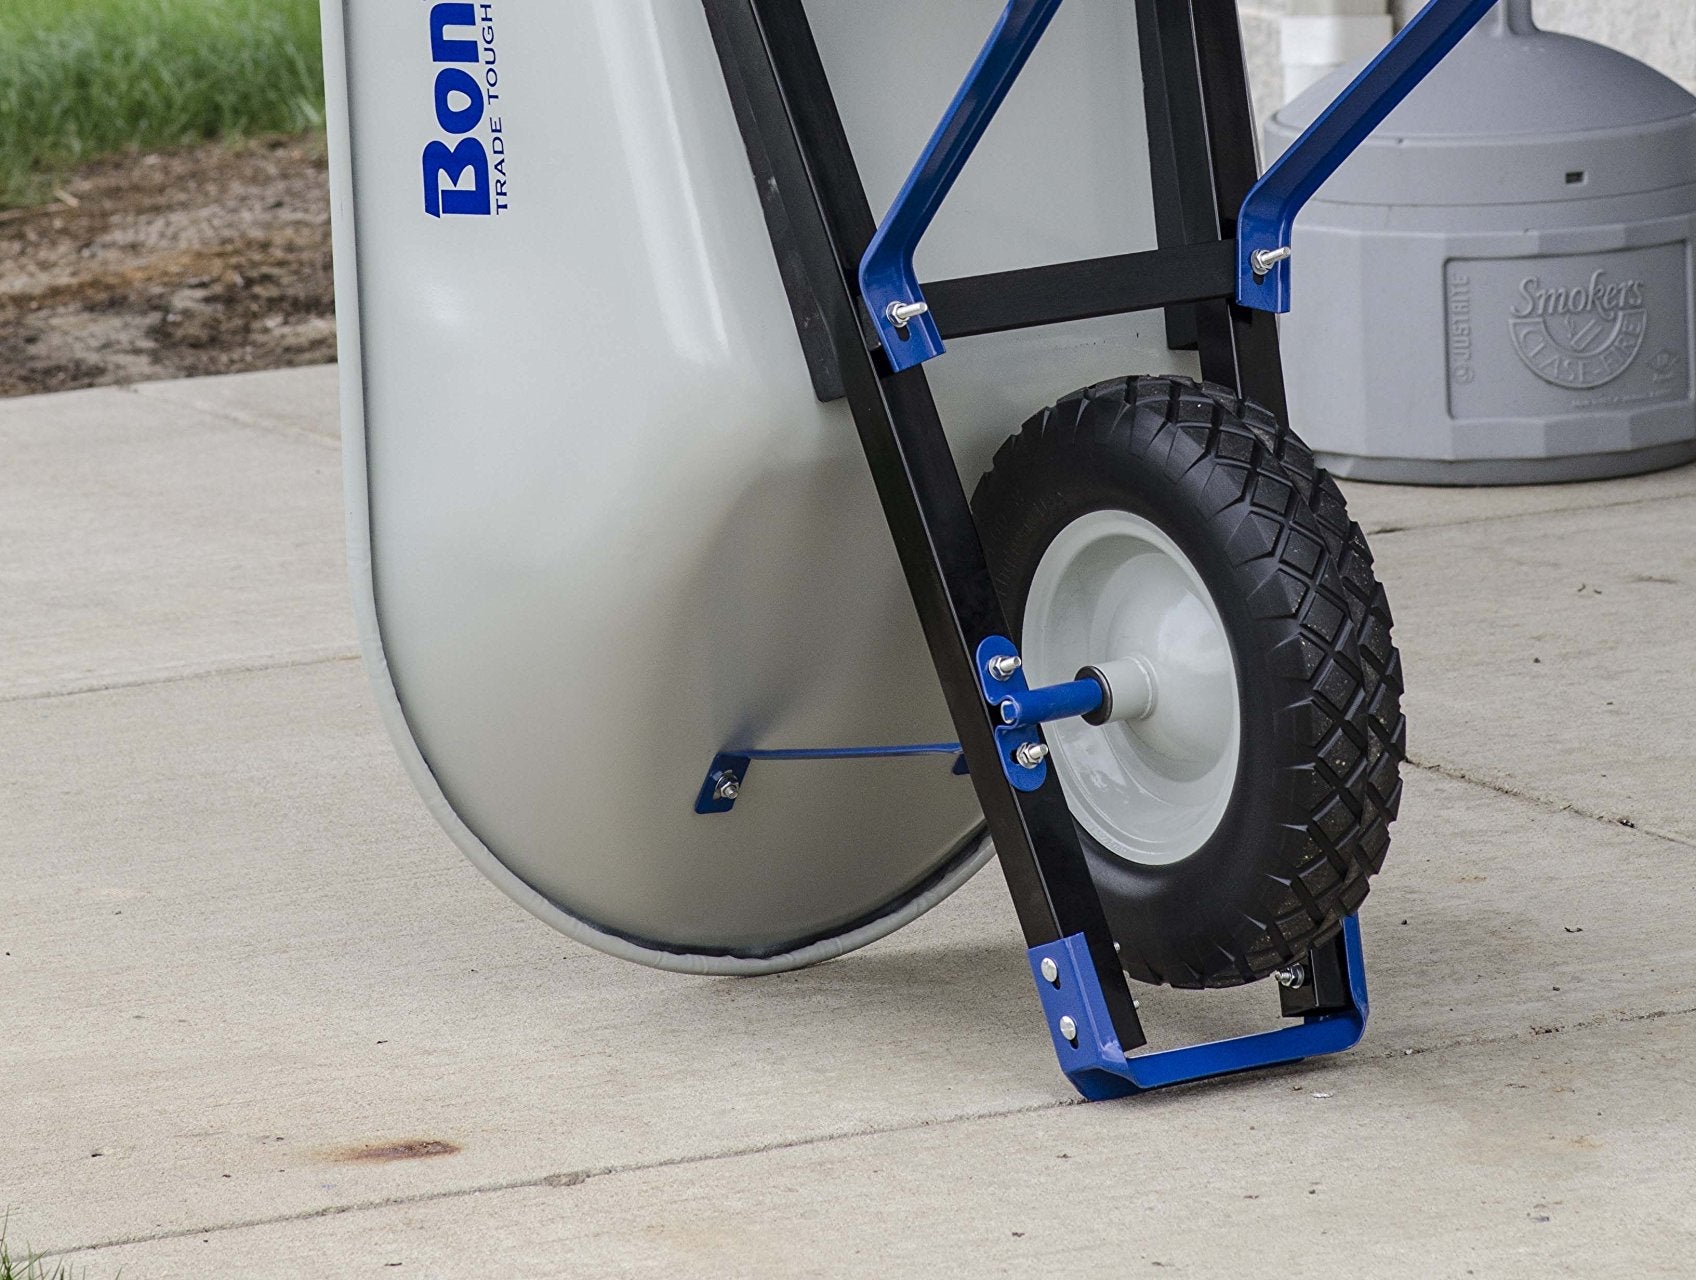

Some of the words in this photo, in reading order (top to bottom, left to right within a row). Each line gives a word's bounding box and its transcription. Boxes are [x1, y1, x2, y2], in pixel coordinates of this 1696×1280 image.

[480, 3, 499, 106] TOUGH
[422, 2, 491, 218] Bon
[490, 117, 508, 215] TRADE
[1451, 274, 1471, 360] JUSTRITE
[1510, 269, 1645, 320] Smokers
